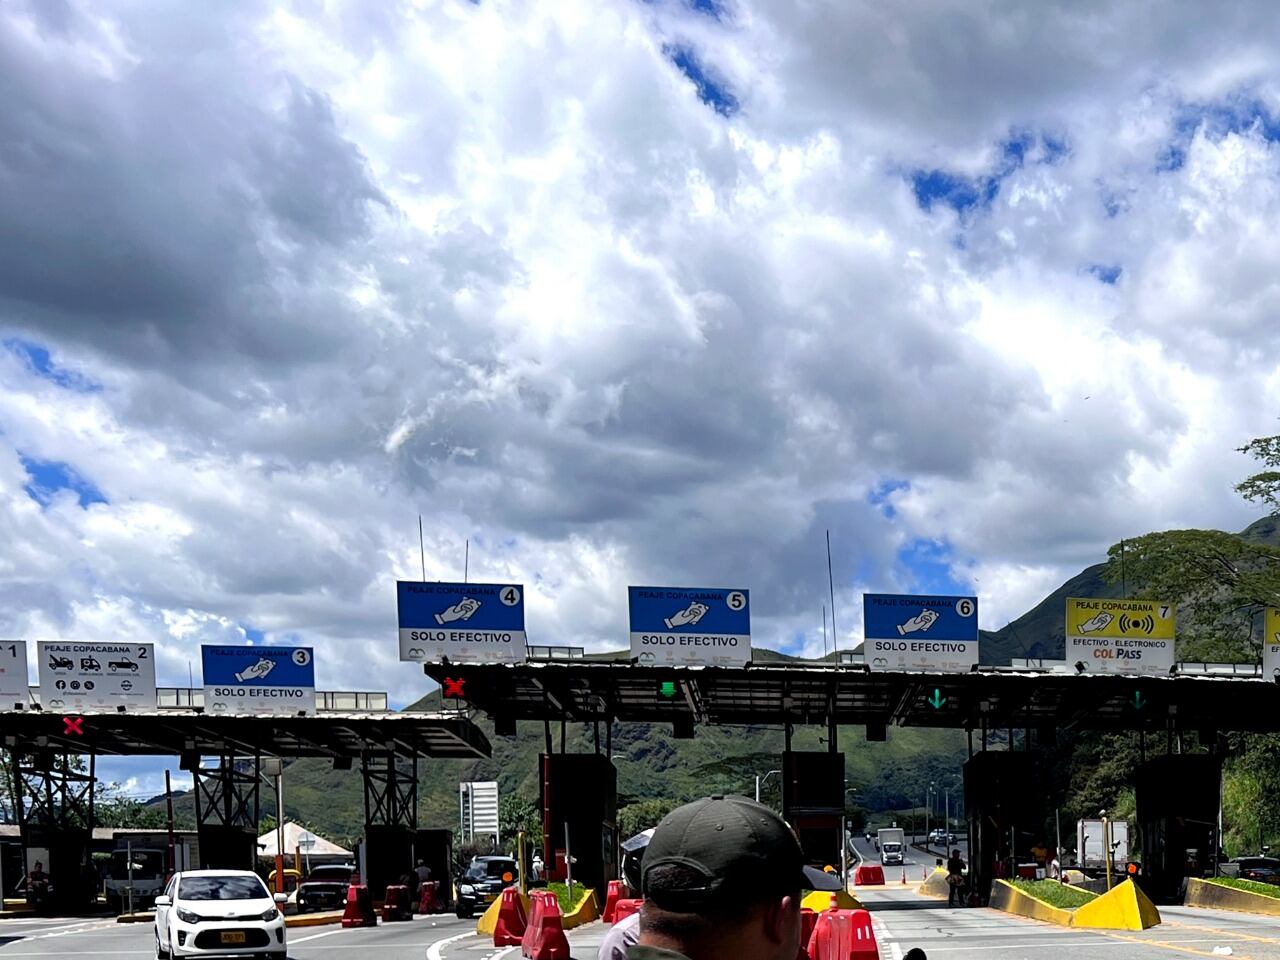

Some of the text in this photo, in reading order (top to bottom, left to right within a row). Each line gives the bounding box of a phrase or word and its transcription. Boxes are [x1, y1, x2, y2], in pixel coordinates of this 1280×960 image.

[437, 587, 495, 595] COPACABANA
[504, 589, 515, 603] 4
[639, 591, 723, 600] PEAJE COPACABANA
[732, 595, 742, 608] 5
[899, 599, 952, 607] COPACABANA
[961, 601, 970, 614] 6
[1102, 603, 1153, 611] COPACABANA
[1161, 606, 1169, 618] 7
[411, 632, 511, 642] SOLO EFECTIVO
[642, 636, 737, 646] SOLO EFECTIVO
[876, 642, 966, 652] SOLO EFECTIVO
[1115, 640, 1166, 648] ELECTRONICO
[8, 645, 16, 657] 1
[138, 647, 147, 658] 2
[1094, 649, 1114, 658] COL
[296, 651, 306, 663] 3
[215, 688, 303, 697] SOLO EFECTIVO
